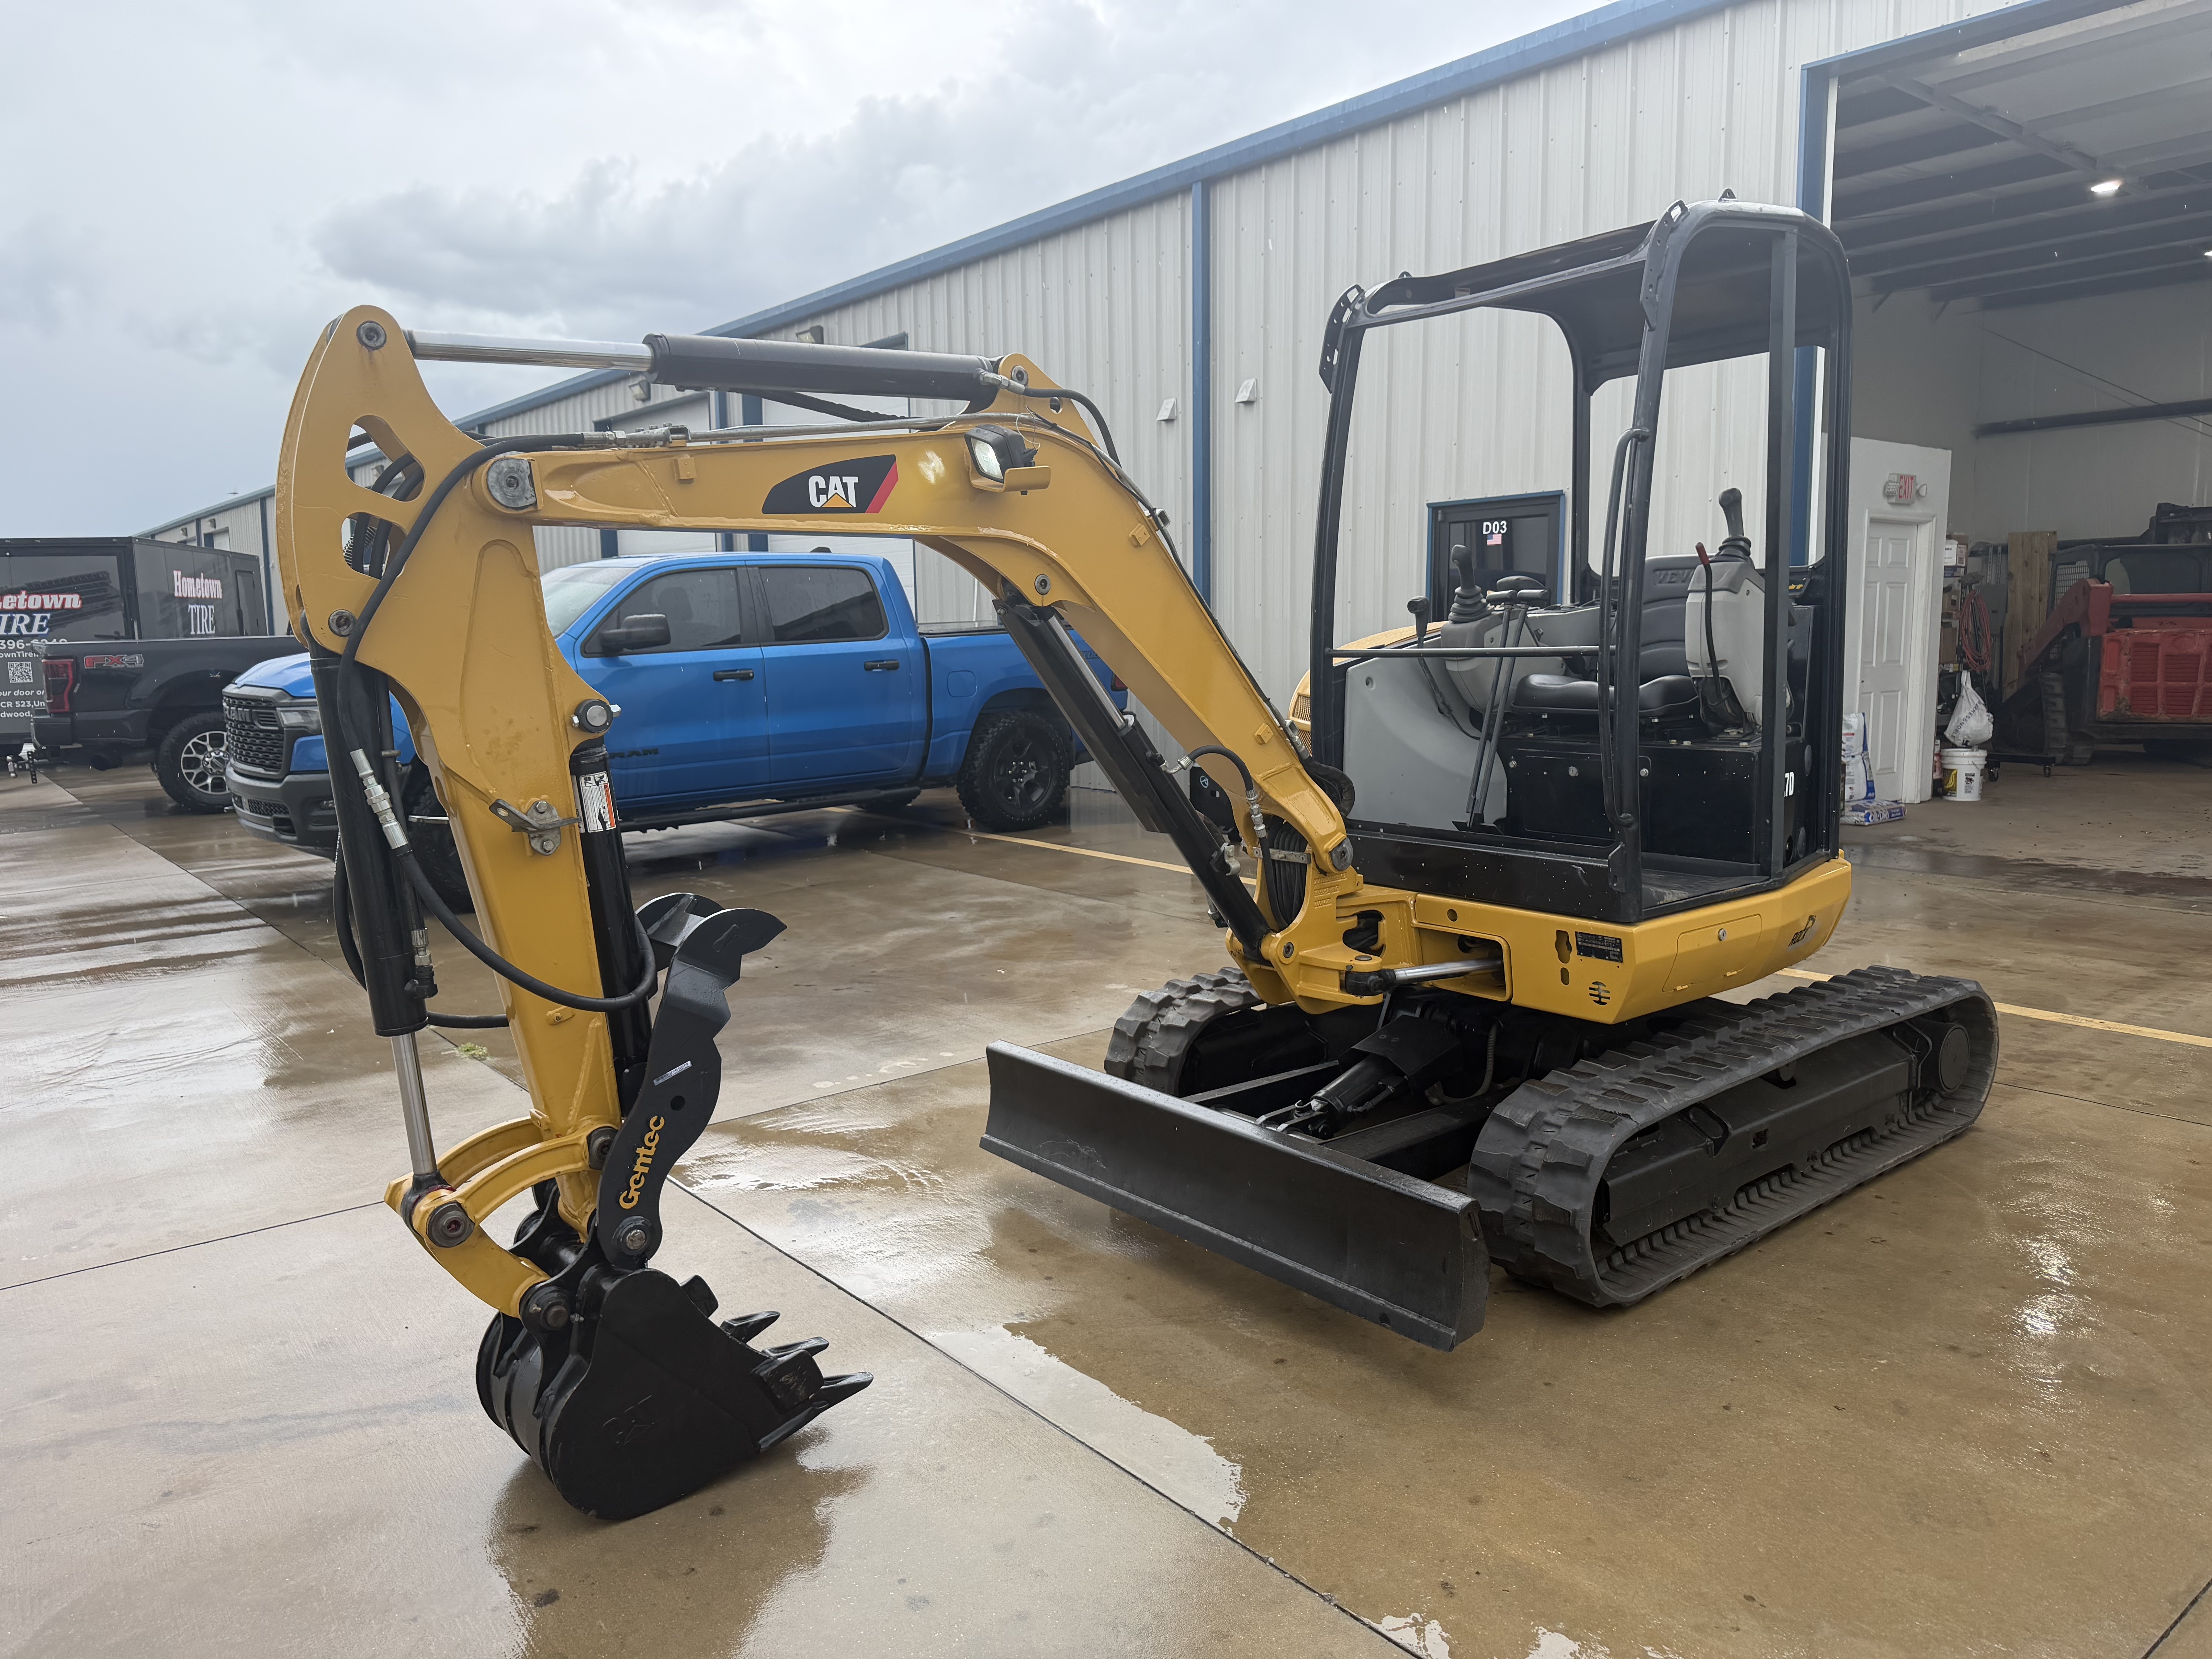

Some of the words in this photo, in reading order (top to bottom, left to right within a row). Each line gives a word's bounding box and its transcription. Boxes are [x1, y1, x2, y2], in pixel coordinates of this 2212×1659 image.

[808, 475, 858, 508] CAT
[1899, 476, 1915, 500] EXIT
[1483, 520, 1507, 534] D03
[173, 570, 223, 599] Hometown
[0, 590, 82, 610] etown
[188, 603, 215, 635] TIRE
[84, 654, 144, 668] FX4
[610, 748, 658, 758] RAM
[620, 1115, 665, 1209] Gentec
